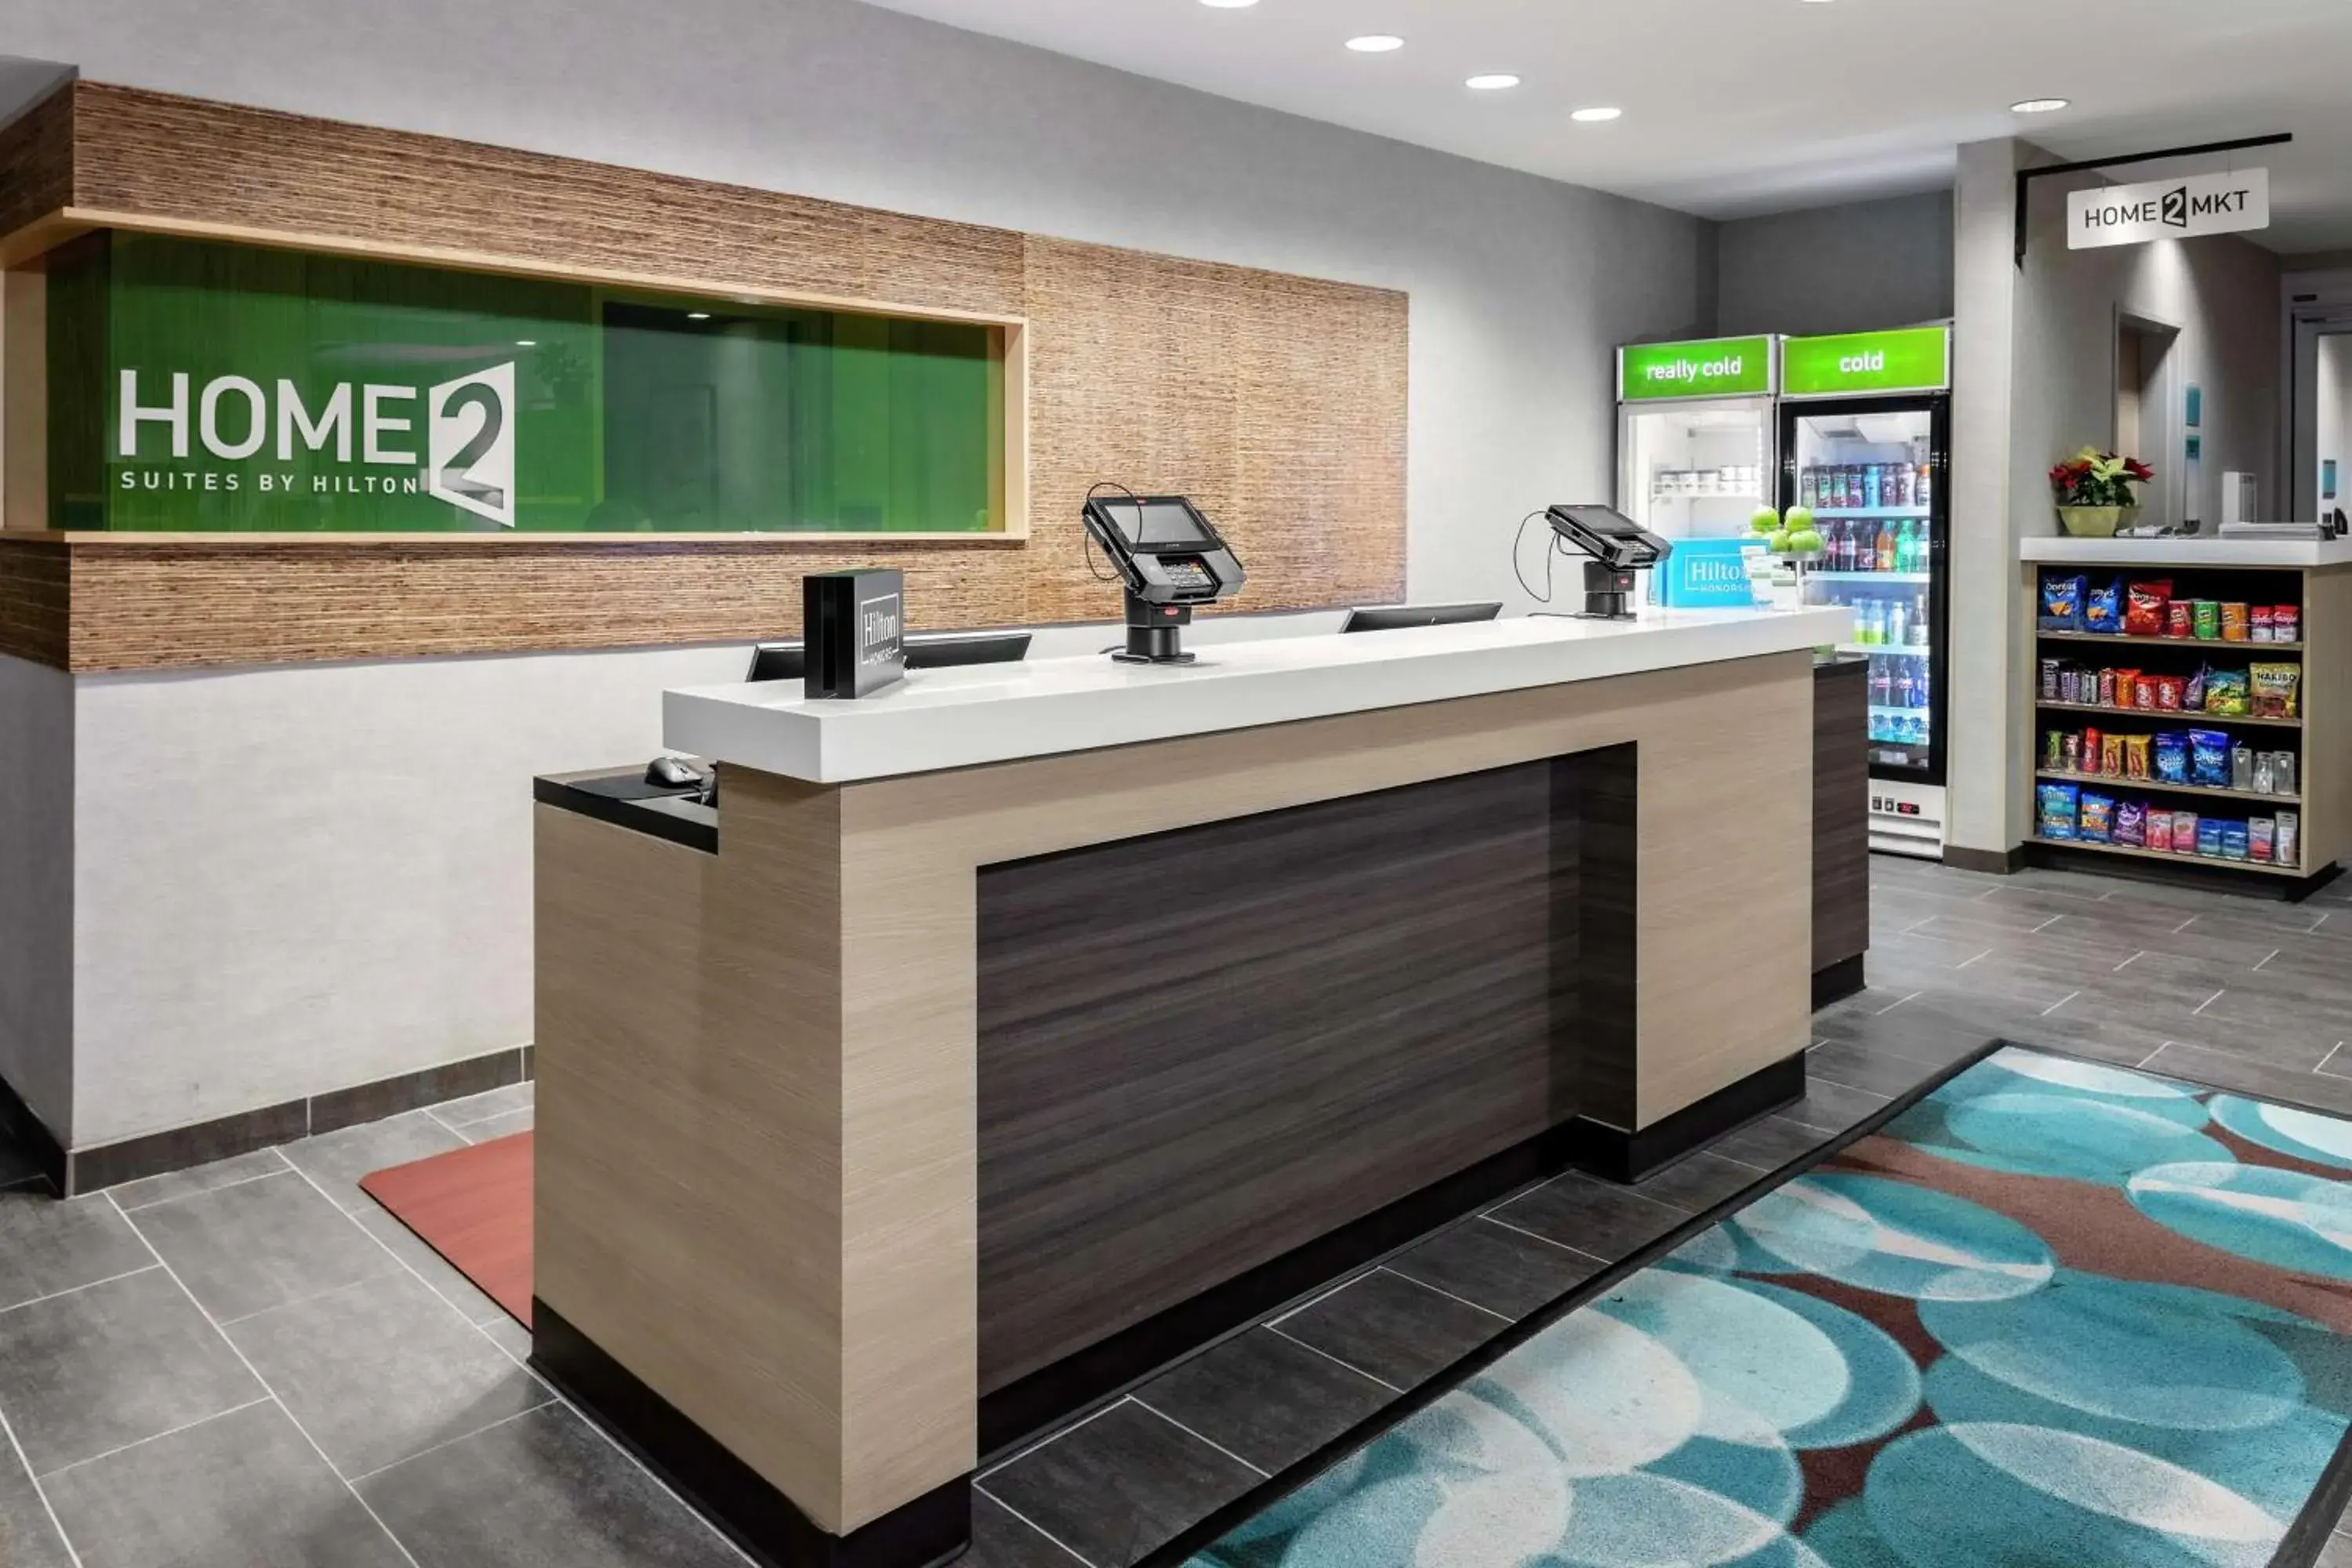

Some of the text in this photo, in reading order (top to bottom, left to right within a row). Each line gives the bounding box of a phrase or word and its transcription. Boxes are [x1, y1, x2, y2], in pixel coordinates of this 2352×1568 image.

[2192, 190, 2249, 216] MKT
[1646, 356, 1742, 383] really cold
[1839, 351, 1886, 372] cold
[122, 472, 416, 494] SUITES BY HILTON
[1691, 561, 1744, 582] Hilto
[864, 611, 896, 647] Hilton
